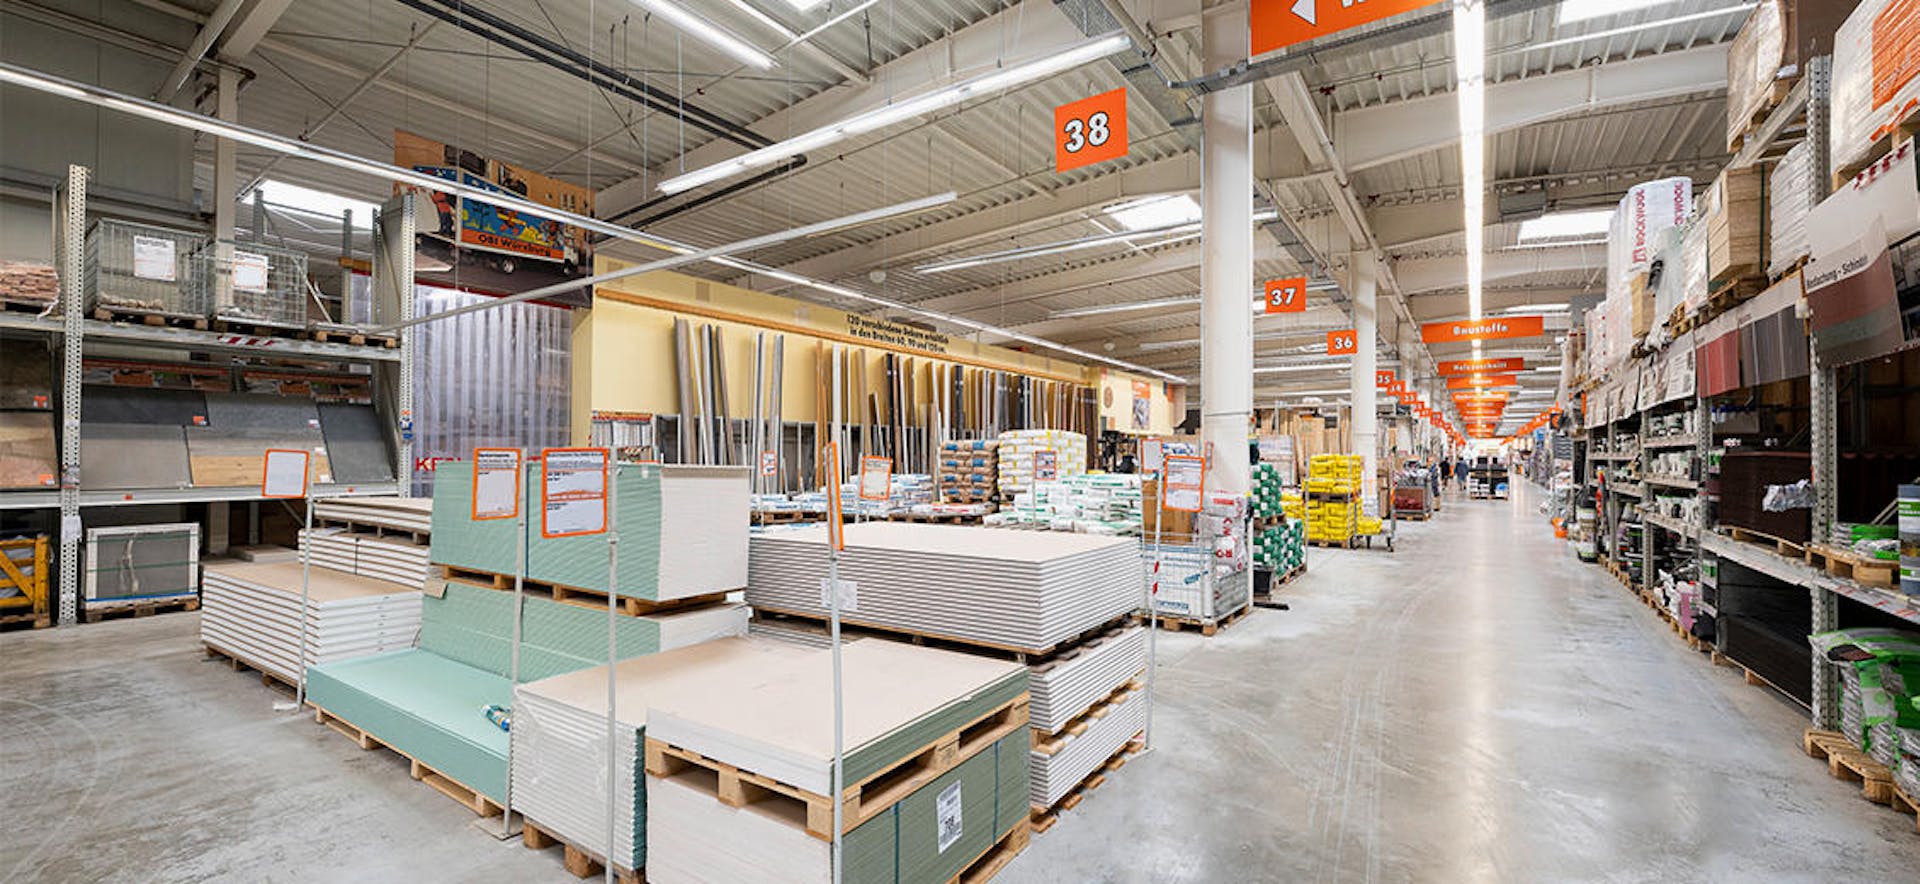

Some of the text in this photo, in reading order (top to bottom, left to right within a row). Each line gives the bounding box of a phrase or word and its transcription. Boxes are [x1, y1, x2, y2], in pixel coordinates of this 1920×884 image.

[1064, 111, 1110, 153] 38
[1270, 288, 1296, 306] 37
[1453, 323, 1508, 336] Baustoffe
[1334, 337, 1353, 350] 36
[1377, 375, 1391, 384] 35
